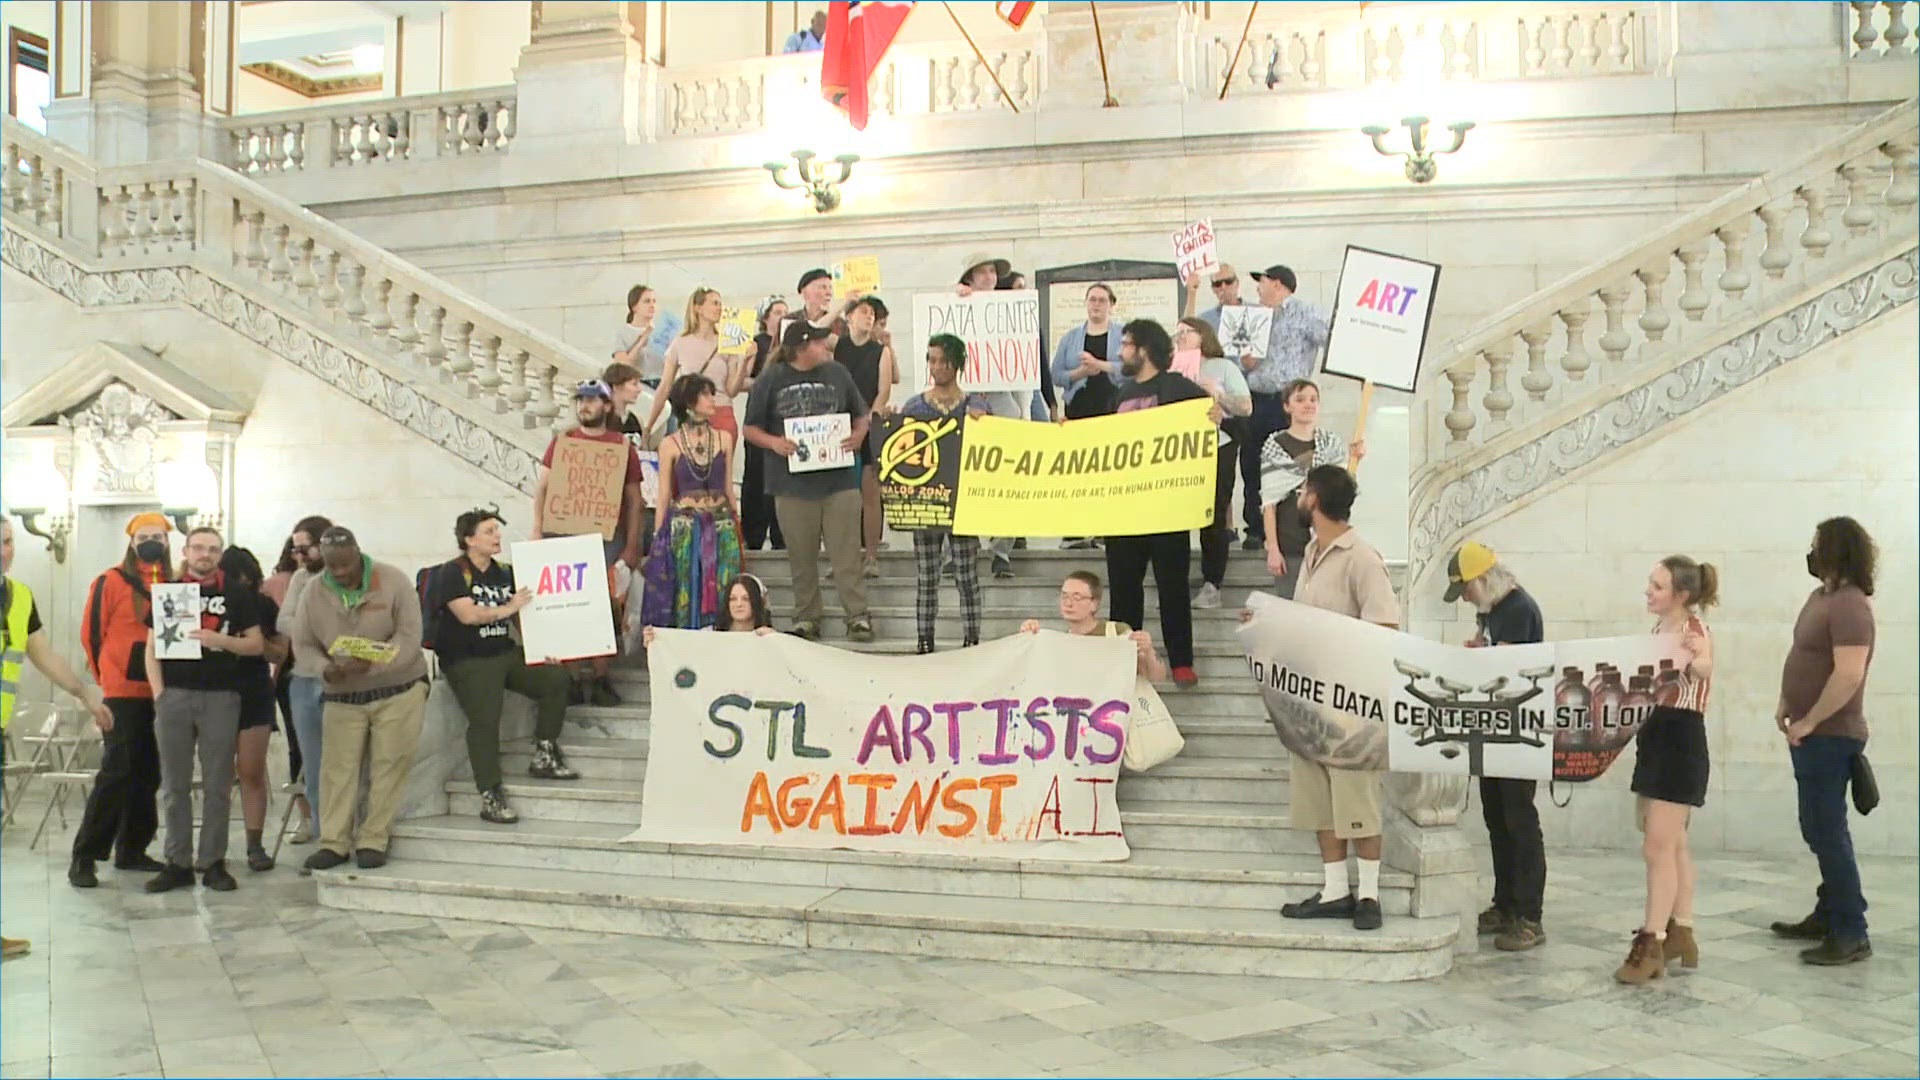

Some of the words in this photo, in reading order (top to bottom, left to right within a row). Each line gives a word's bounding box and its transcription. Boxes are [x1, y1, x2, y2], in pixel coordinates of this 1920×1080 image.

[1173, 222, 1209, 246] DATA
[1356, 279, 1419, 316] ART
[928, 303, 976, 336] DATA
[985, 299, 1039, 334] CENTER
[986, 338, 1039, 383] NOW
[561, 448, 586, 465] NO
[594, 452, 620, 468] MO
[964, 445, 1043, 476] NO-AI
[1048, 440, 1144, 476] ANALOG
[1150, 430, 1216, 465] ZONE
[568, 465, 612, 486] DIRTY
[568, 482, 608, 500] DATA
[967, 487, 985, 497] THIS
[988, 488, 996, 497] IS
[998, 488, 1003, 498] A
[1006, 489, 1030, 499] SPACE
[1033, 489, 1048, 499] FOR
[1071, 488, 1087, 498] FOR
[1108, 486, 1123, 496] FOR
[1125, 481, 1153, 494] HUMAN
[1155, 475, 1206, 490] EXPRESSION
[537, 562, 588, 596] ART
[1271, 663, 1325, 704] MORE
[1333, 683, 1384, 722] DATA
[1394, 701, 1510, 730] CENTERS
[1521, 707, 1545, 730] IN
[1556, 706, 1591, 728] ST.
[703, 694, 832, 761] STL
[856, 696, 1131, 766] ARTISTS
[741, 771, 1017, 837] AGAINST
